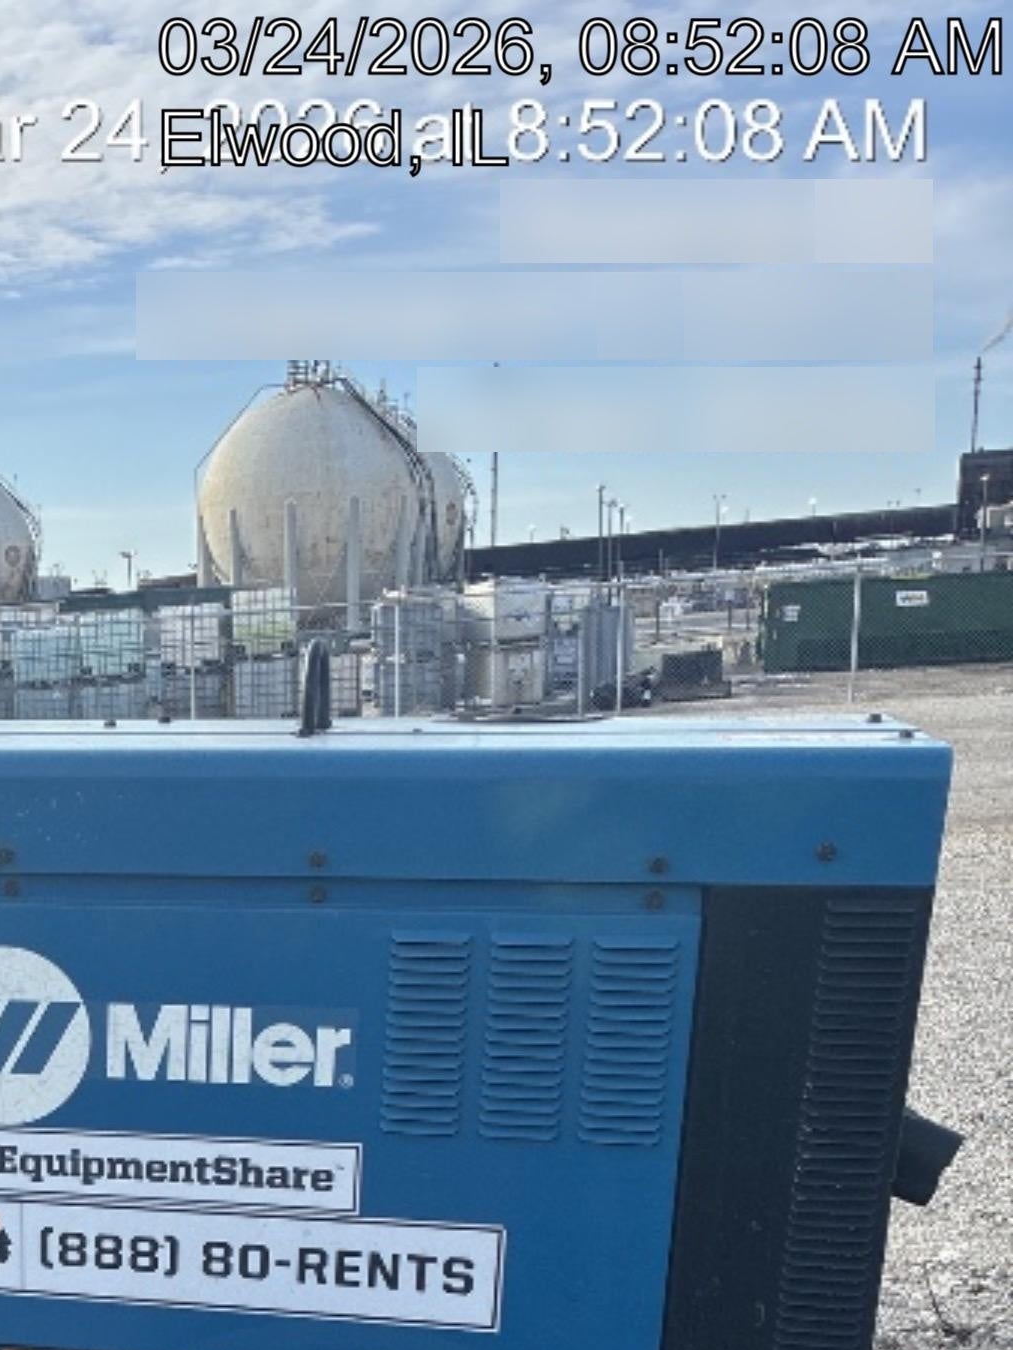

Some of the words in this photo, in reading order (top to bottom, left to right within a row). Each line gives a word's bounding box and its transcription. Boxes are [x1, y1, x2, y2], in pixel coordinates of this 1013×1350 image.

[105, 1002, 352, 1088] Miller
[39, 1226, 180, 1276] (888)
[201, 1240, 476, 1296] 80-RENTS
